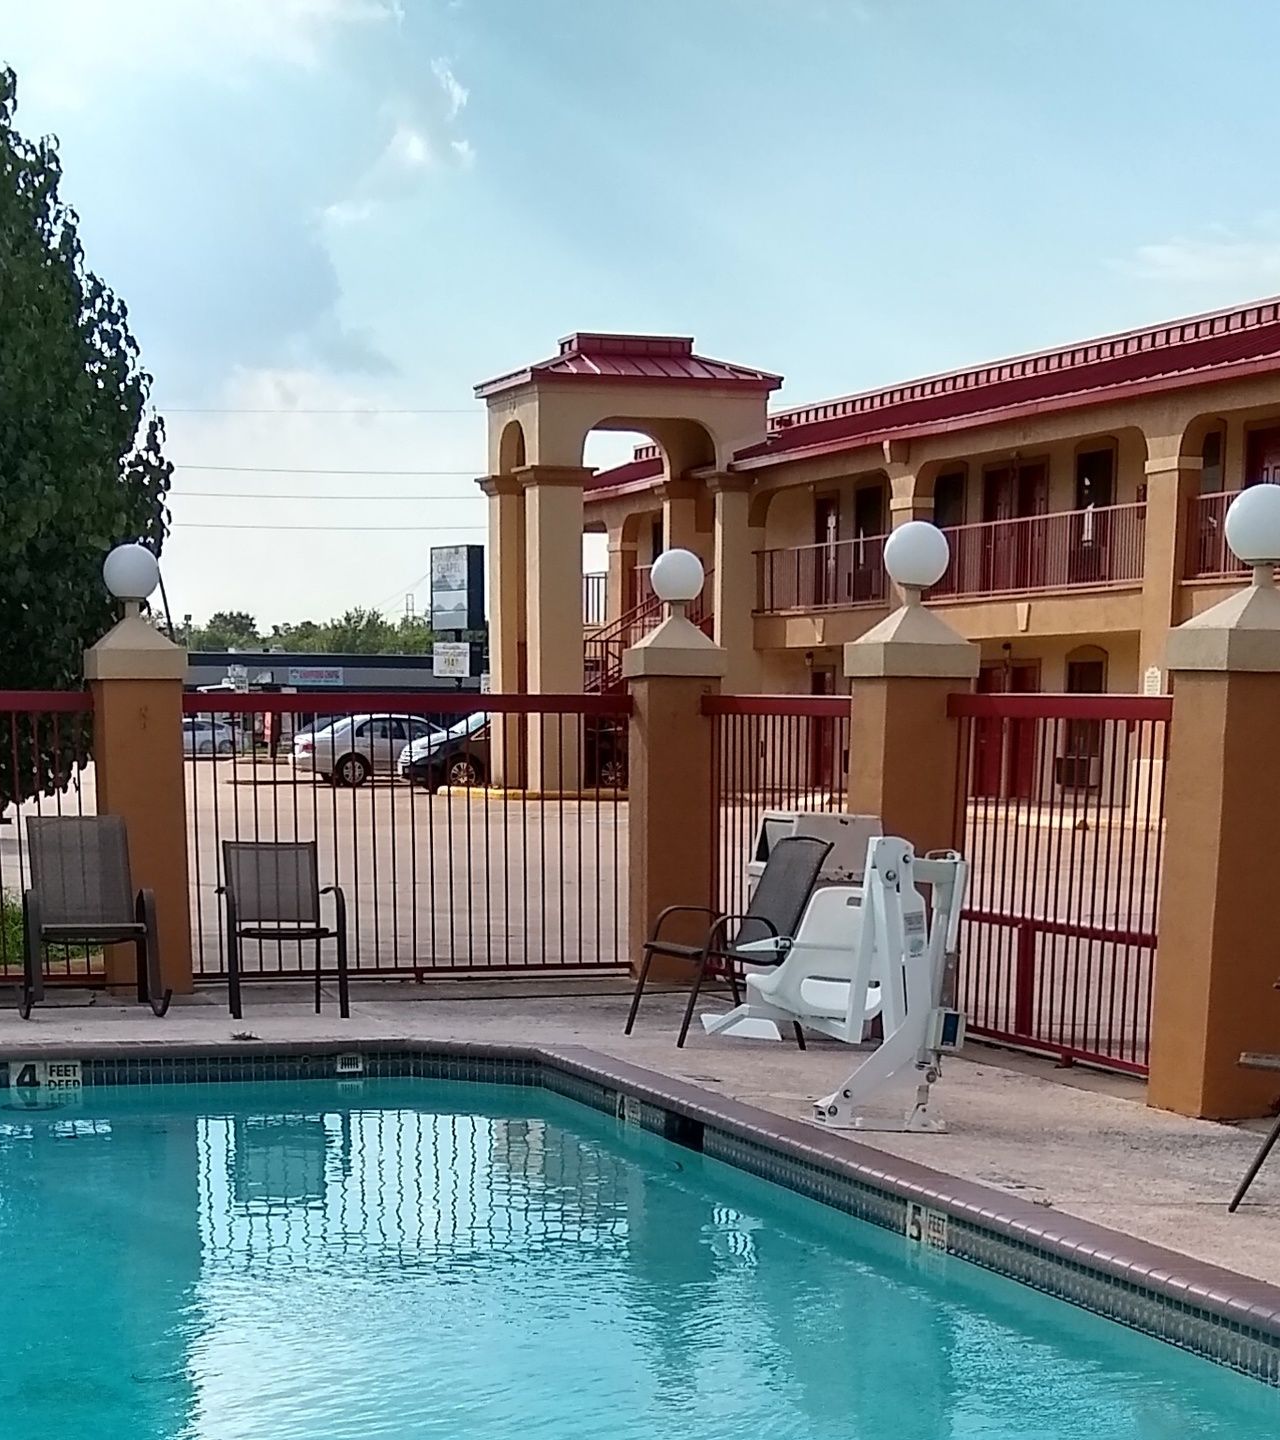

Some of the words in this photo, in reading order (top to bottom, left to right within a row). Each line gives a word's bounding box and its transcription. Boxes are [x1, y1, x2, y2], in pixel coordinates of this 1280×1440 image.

[16, 1064, 41, 1087] 4
[49, 1064, 78, 1077] FEET
[910, 1204, 922, 1242] 5
[929, 1213, 946, 1236] FEET
